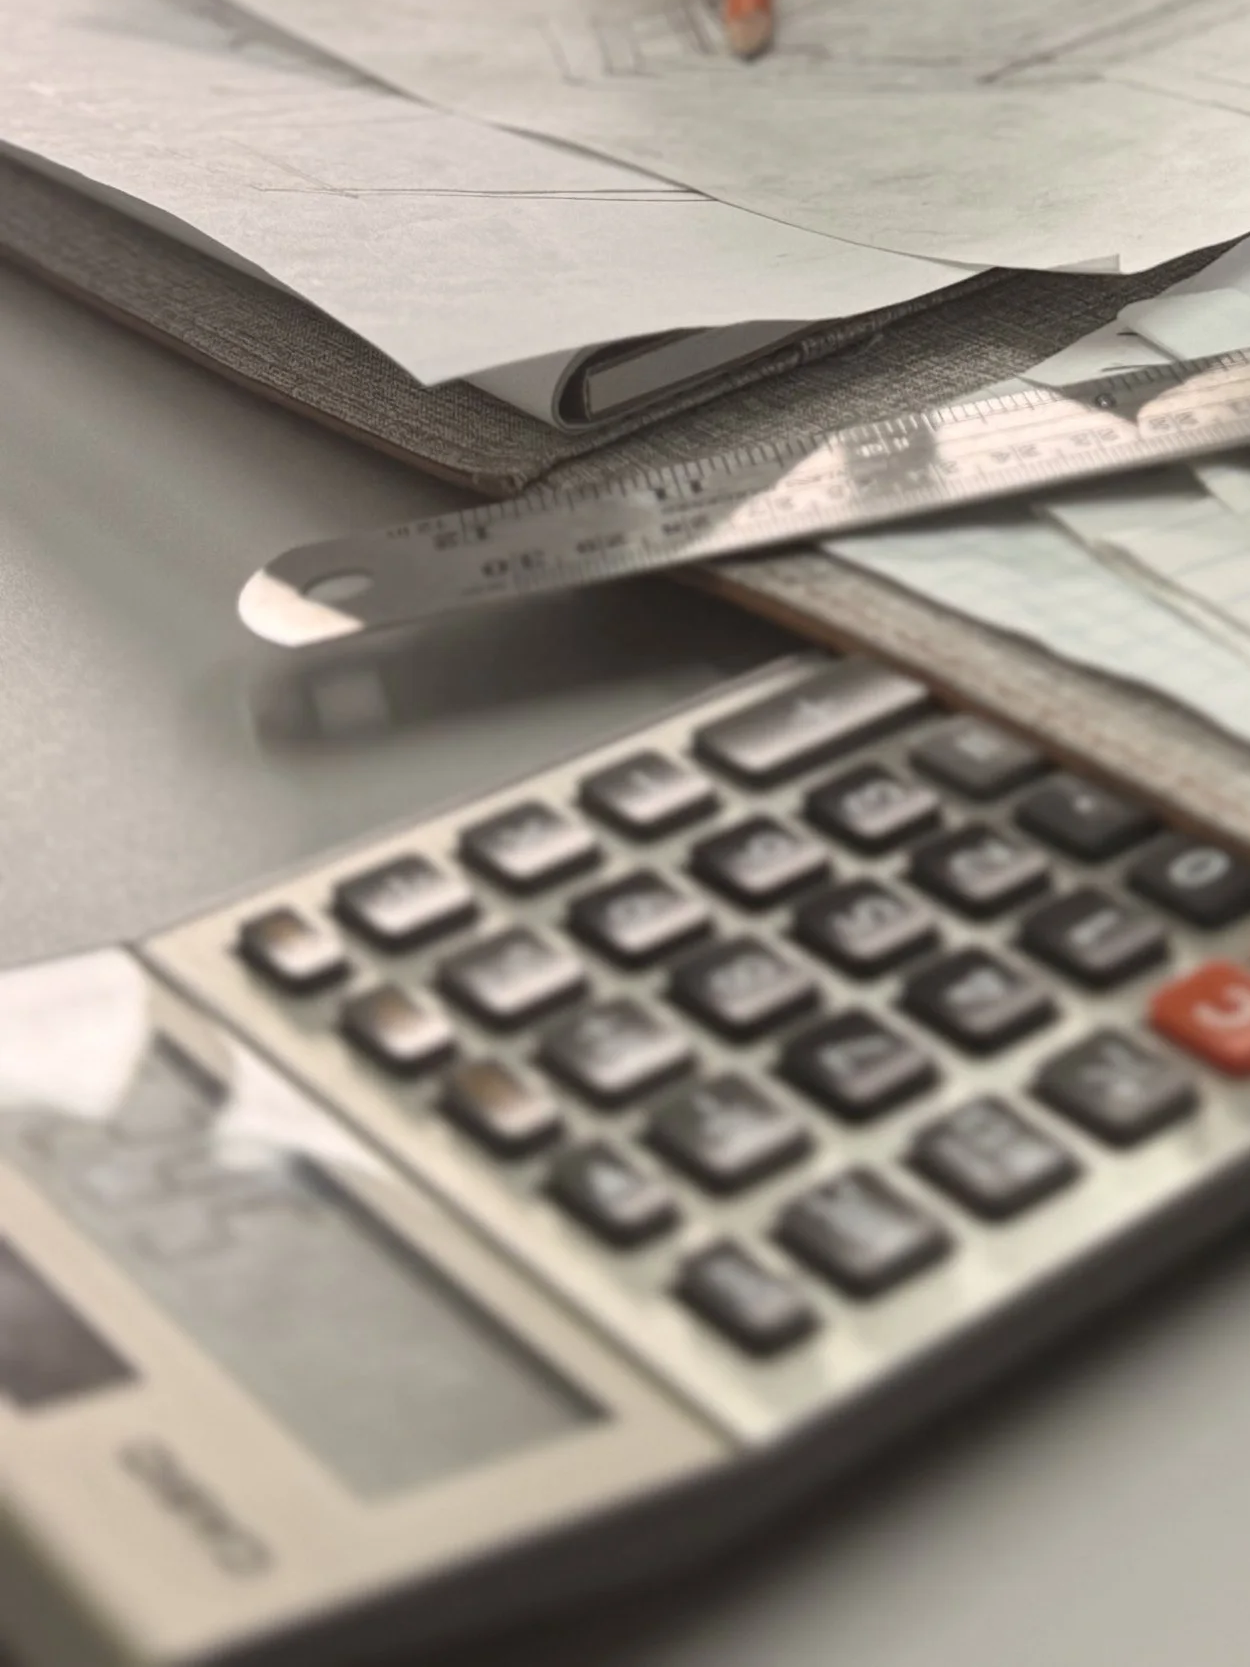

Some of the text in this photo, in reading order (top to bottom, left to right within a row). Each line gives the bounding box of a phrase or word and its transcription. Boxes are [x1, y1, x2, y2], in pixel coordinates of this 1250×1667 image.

[1168, 847, 1231, 889] 0
[1070, 909, 1118, 945] 1
[820, 1036, 893, 1072] 7
